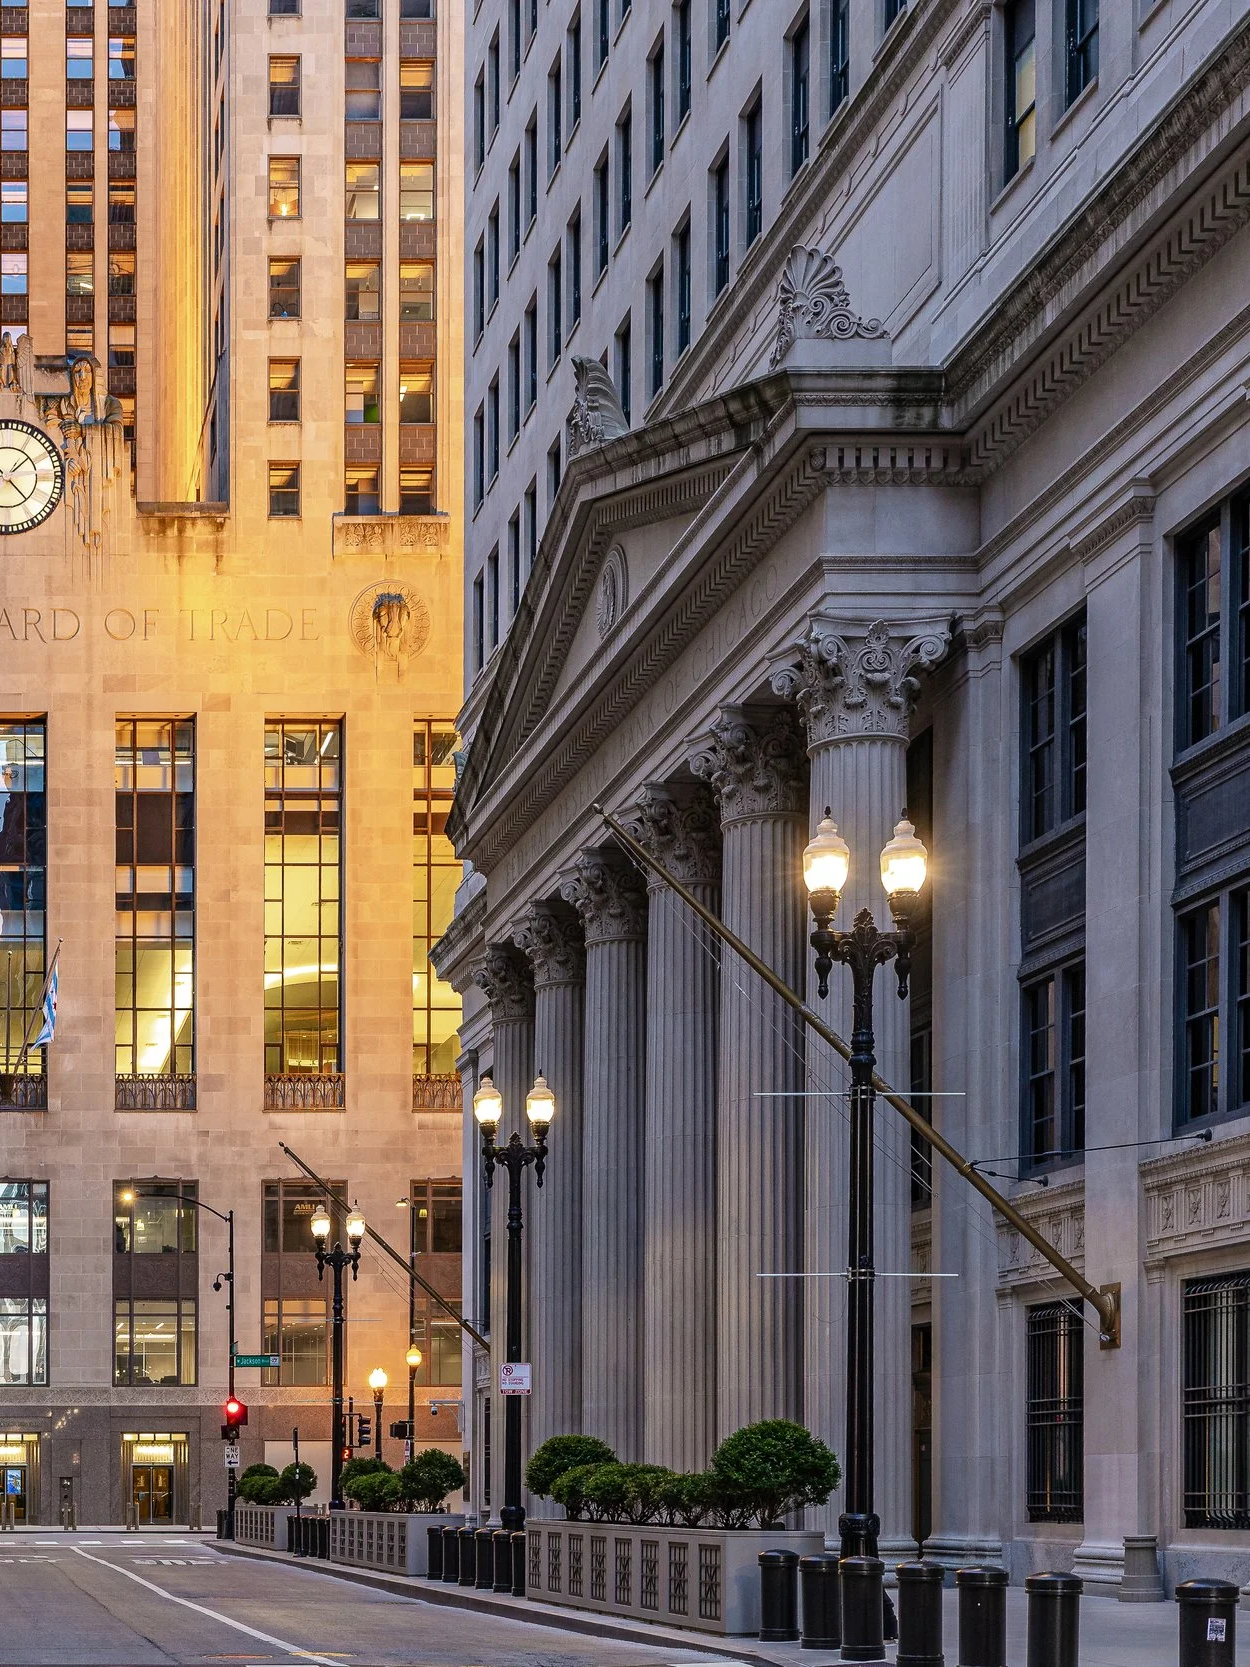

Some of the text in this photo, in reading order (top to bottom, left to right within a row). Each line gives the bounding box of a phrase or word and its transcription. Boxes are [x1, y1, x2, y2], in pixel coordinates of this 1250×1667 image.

[104, 607, 159, 642] OF
[179, 607, 320, 643] TRADE
[692, 565, 778, 682] CHICAGO
[241, 1357, 260, 1365] Jackson
